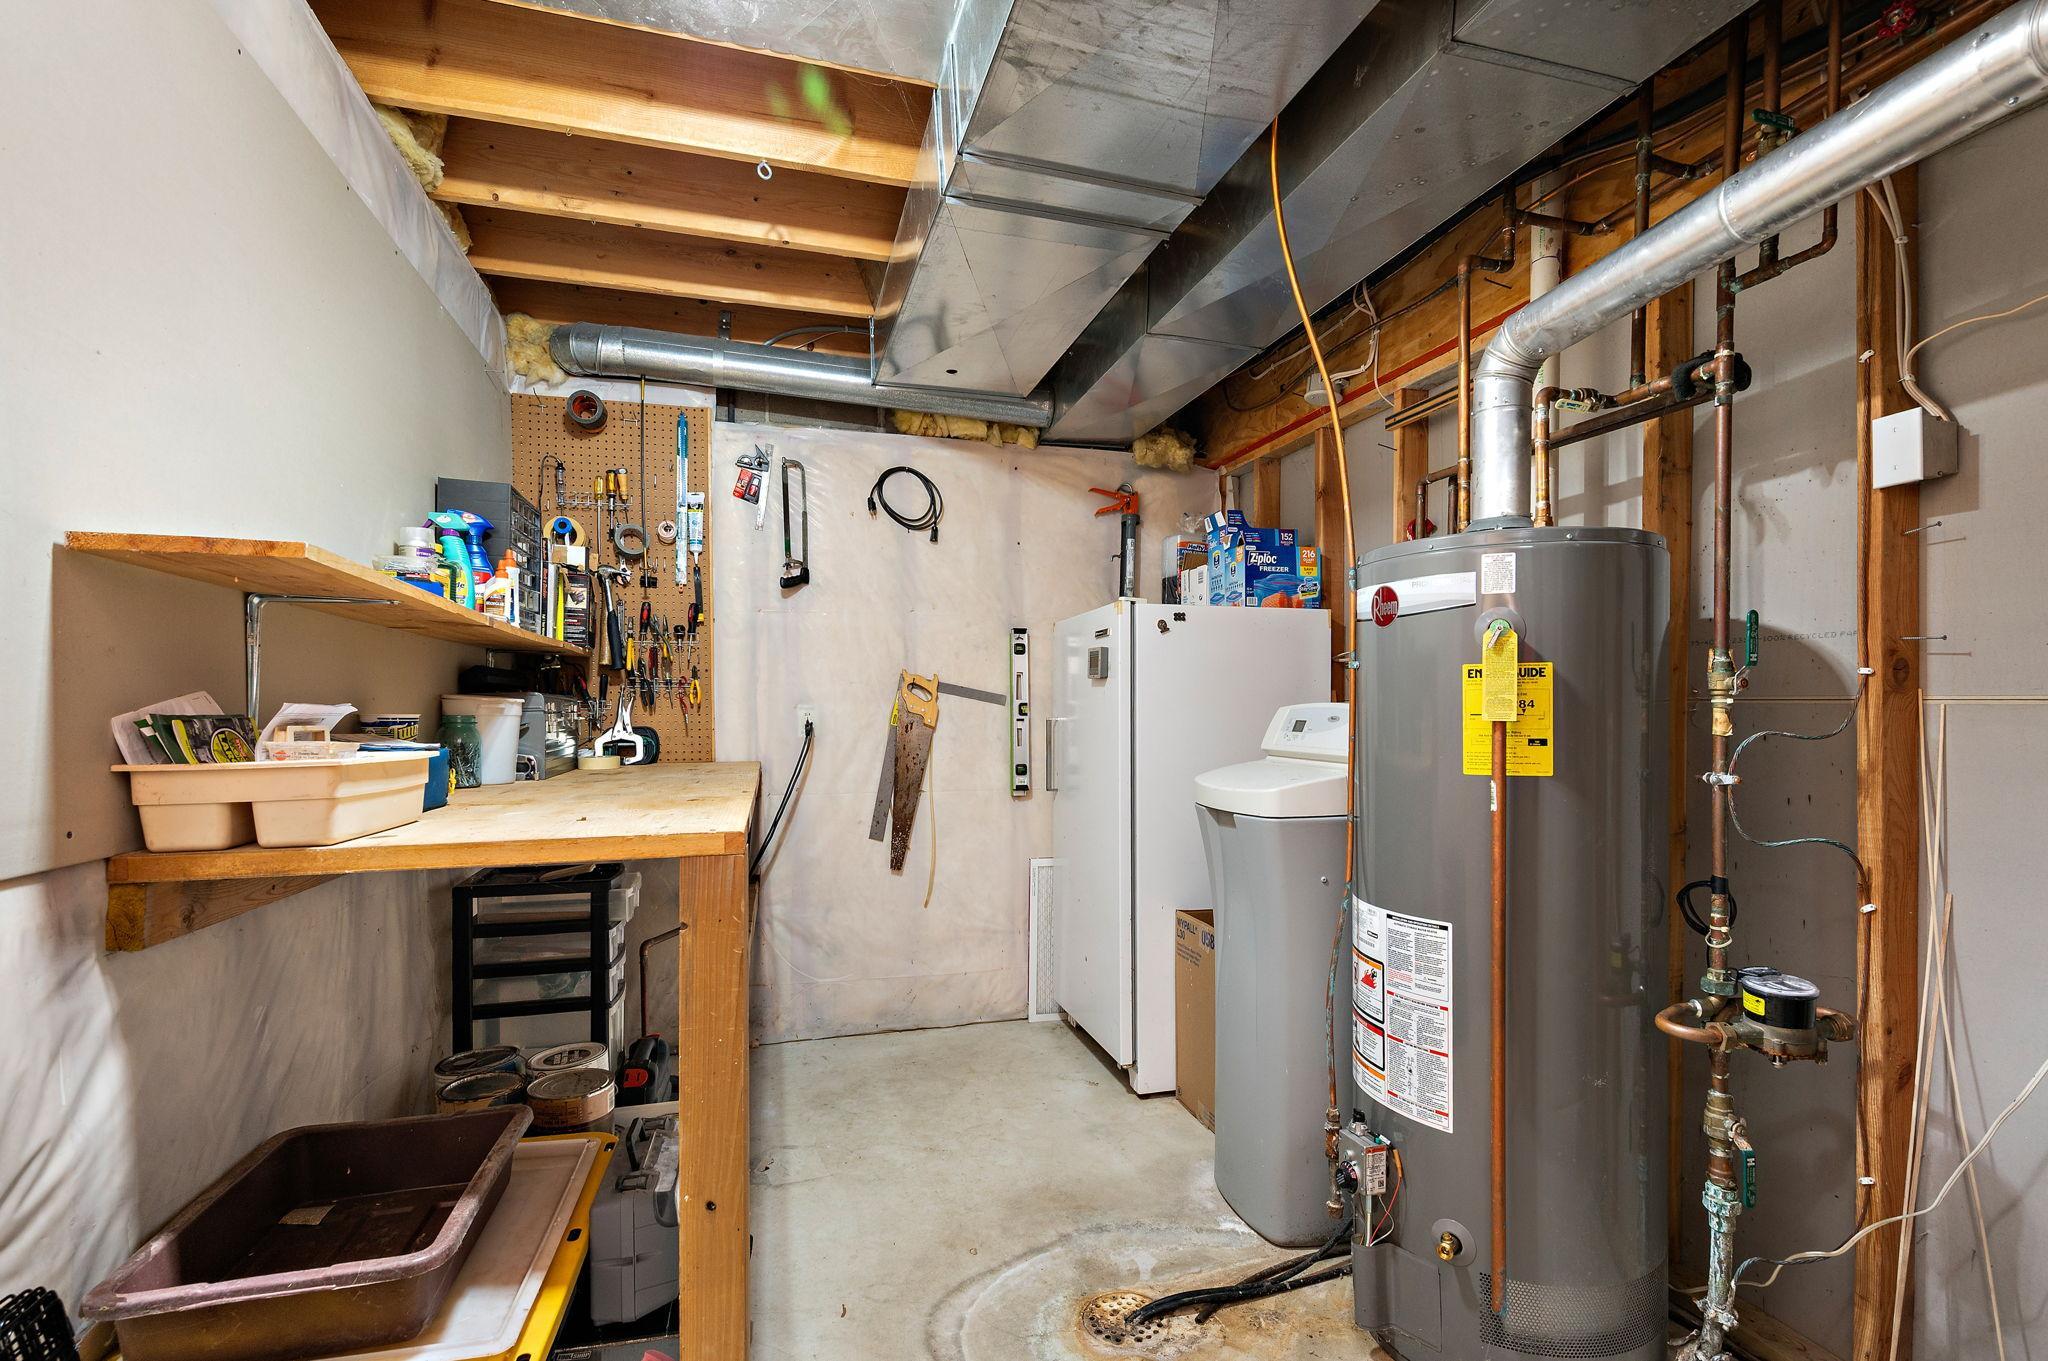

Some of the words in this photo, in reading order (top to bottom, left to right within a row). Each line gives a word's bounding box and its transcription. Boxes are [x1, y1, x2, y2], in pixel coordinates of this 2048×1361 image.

[1281, 533, 1293, 541] 152
[1250, 552, 1277, 566] Ziploc
[1302, 550, 1315, 558] 216
[1373, 588, 1398, 622] Rheem
[1517, 699, 1535, 709] 84
